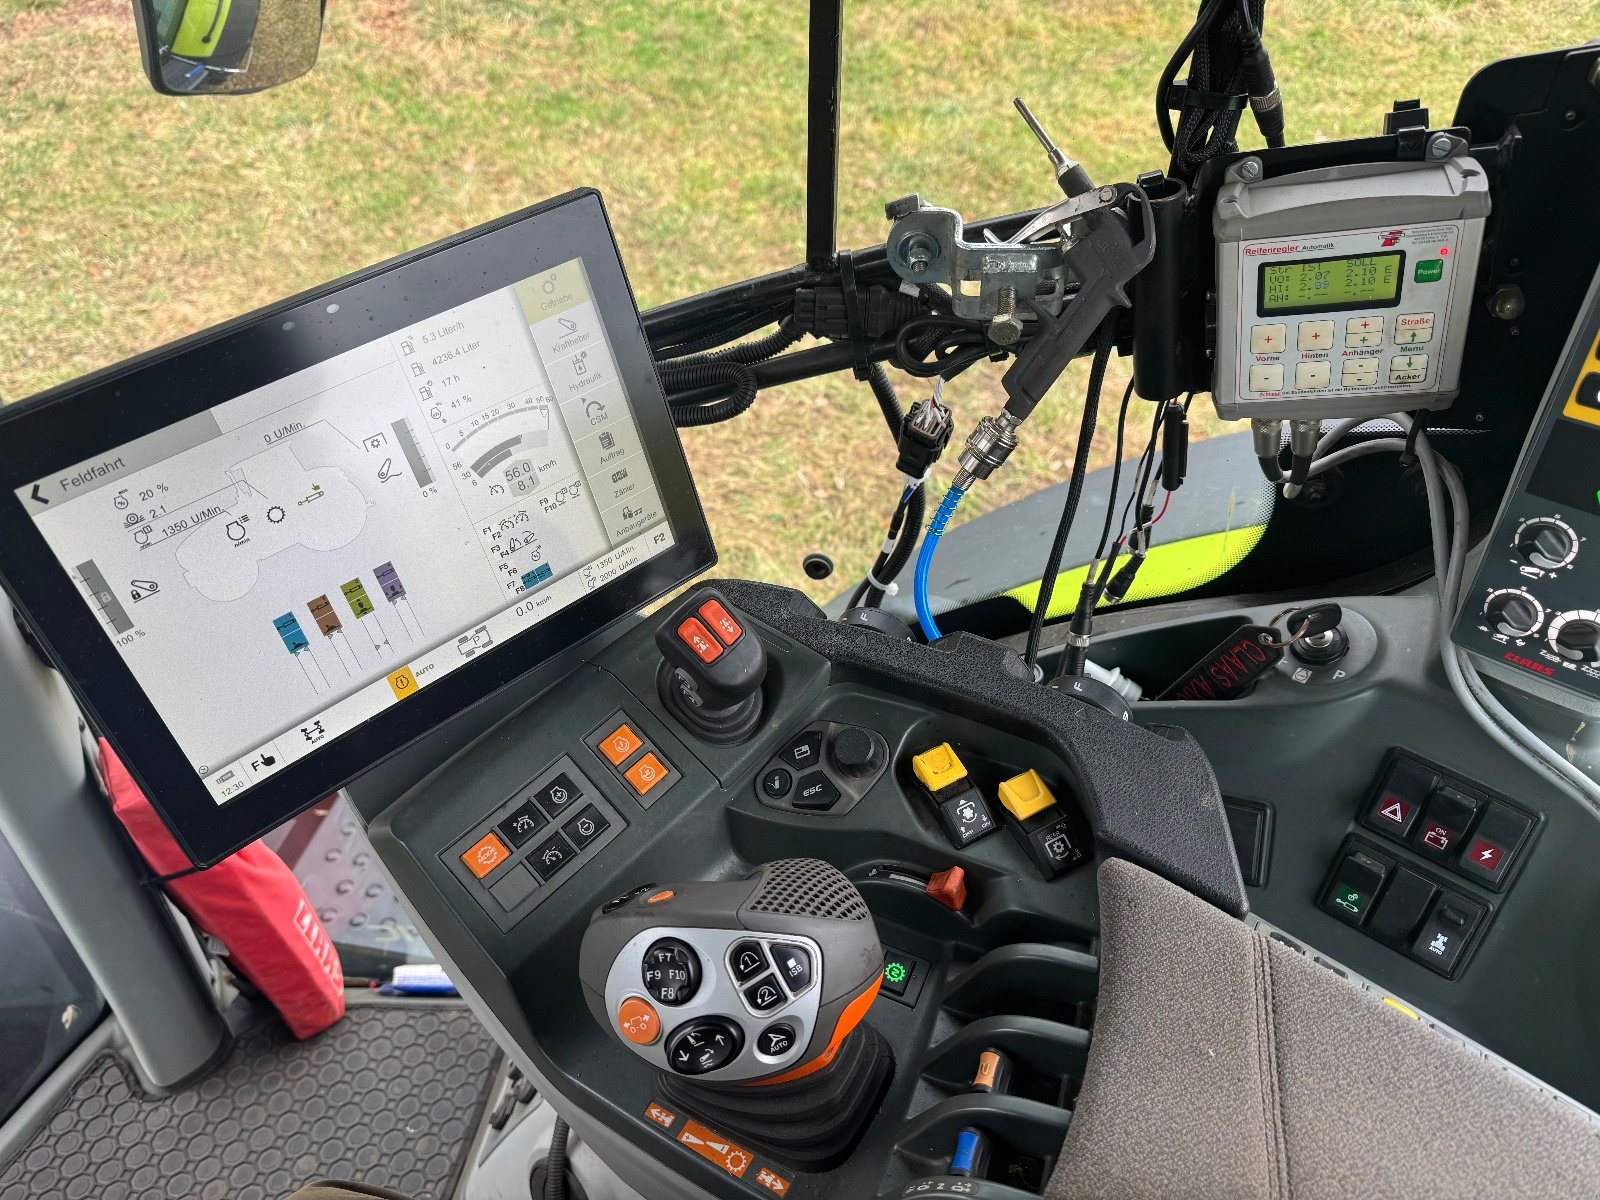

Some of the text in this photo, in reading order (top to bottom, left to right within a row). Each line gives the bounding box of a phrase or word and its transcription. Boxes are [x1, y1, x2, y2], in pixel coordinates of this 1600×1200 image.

[1245, 242, 1335, 256] Reifenregler Automatik
[1302, 263, 1321, 272] IST
[1346, 257, 1378, 268] SOLL
[1299, 271, 1330, 282] 2.07
[1345, 267, 1376, 278] 2.10
[1385, 265, 1393, 274] E
[1269, 275, 1392, 294] HI: 2.09 2.10 E
[540, 293, 574, 311] Getriebe
[1400, 317, 1432, 327] Straße
[422, 321, 465, 344] 5.3 Liter/h
[551, 332, 591, 354] Kraftheber
[1400, 345, 1424, 353] Menu
[432, 340, 481, 366] 4236.4 Liter
[1255, 354, 1280, 362] Vorne
[1301, 351, 1329, 360] Hinten
[1341, 347, 1384, 358] Anhänger
[441, 374, 461, 388] 17 h
[568, 372, 603, 392] Hydraulik
[1395, 373, 1421, 381] Acker
[451, 394, 472, 409] 41 %
[506, 401, 516, 410] 30
[524, 397, 533, 405] 40
[481, 412, 490, 421] 15
[490, 408, 500, 417] 20
[470, 419, 480, 428] 10
[590, 412, 609, 426] CSM
[263, 420, 306, 444] 0 U/Min.
[459, 429, 464, 437] 5
[445, 442, 451, 450] 0
[600, 448, 625, 465] Auftrag
[59, 457, 126, 492] Feldfahrt
[461, 470, 472, 480] 30
[505, 459, 558, 482] 56.0 km/h
[472, 479, 478, 487] 6
[517, 475, 536, 492] 8.1
[138, 488, 154, 502] 20
[156, 482, 169, 494] %
[422, 485, 438, 498] 0 %
[613, 483, 635, 498] Zähler
[539, 497, 549, 507] F9
[544, 502, 558, 514] F10
[149, 504, 167, 519] 2.1
[161, 505, 225, 537] 1350 U/Min.
[616, 511, 658, 538] Anbaugeräte
[482, 526, 492, 536] F1
[492, 531, 503, 541] F2
[653, 533, 666, 545] F2
[490, 544, 501, 554] F3
[500, 550, 510, 559] F4
[596, 544, 636, 570] 1350 U/Min.
[498, 562, 509, 572] F5
[508, 567, 518, 577] F6
[599, 568, 617, 582] 2000
[506, 580, 516, 590] F7
[515, 585, 526, 595] F8
[515, 594, 552, 617] 0.0 km/h
[116, 629, 146, 648] 100 %
[472, 635, 481, 646] P
[1208, 639, 1266, 688] CLAAS
[1504, 653, 1555, 677] CLAAS
[415, 663, 435, 678] AUTO
[1332, 669, 1346, 680] P
[311, 734, 325, 745] AUTO
[250, 760, 261, 772] F
[221, 780, 245, 798] 12:30
[802, 783, 823, 798] ESC
[1435, 827, 1448, 837] ON
[477, 848, 498, 865] MODE
[1428, 945, 1443, 956] AUTO
[657, 952, 672, 963] F7
[646, 970, 661, 981] F9
[668, 969, 687, 981] F10
[660, 987, 675, 999] F8
[760, 989, 771, 1001] 2
[769, 1039, 788, 1053] AUTO
